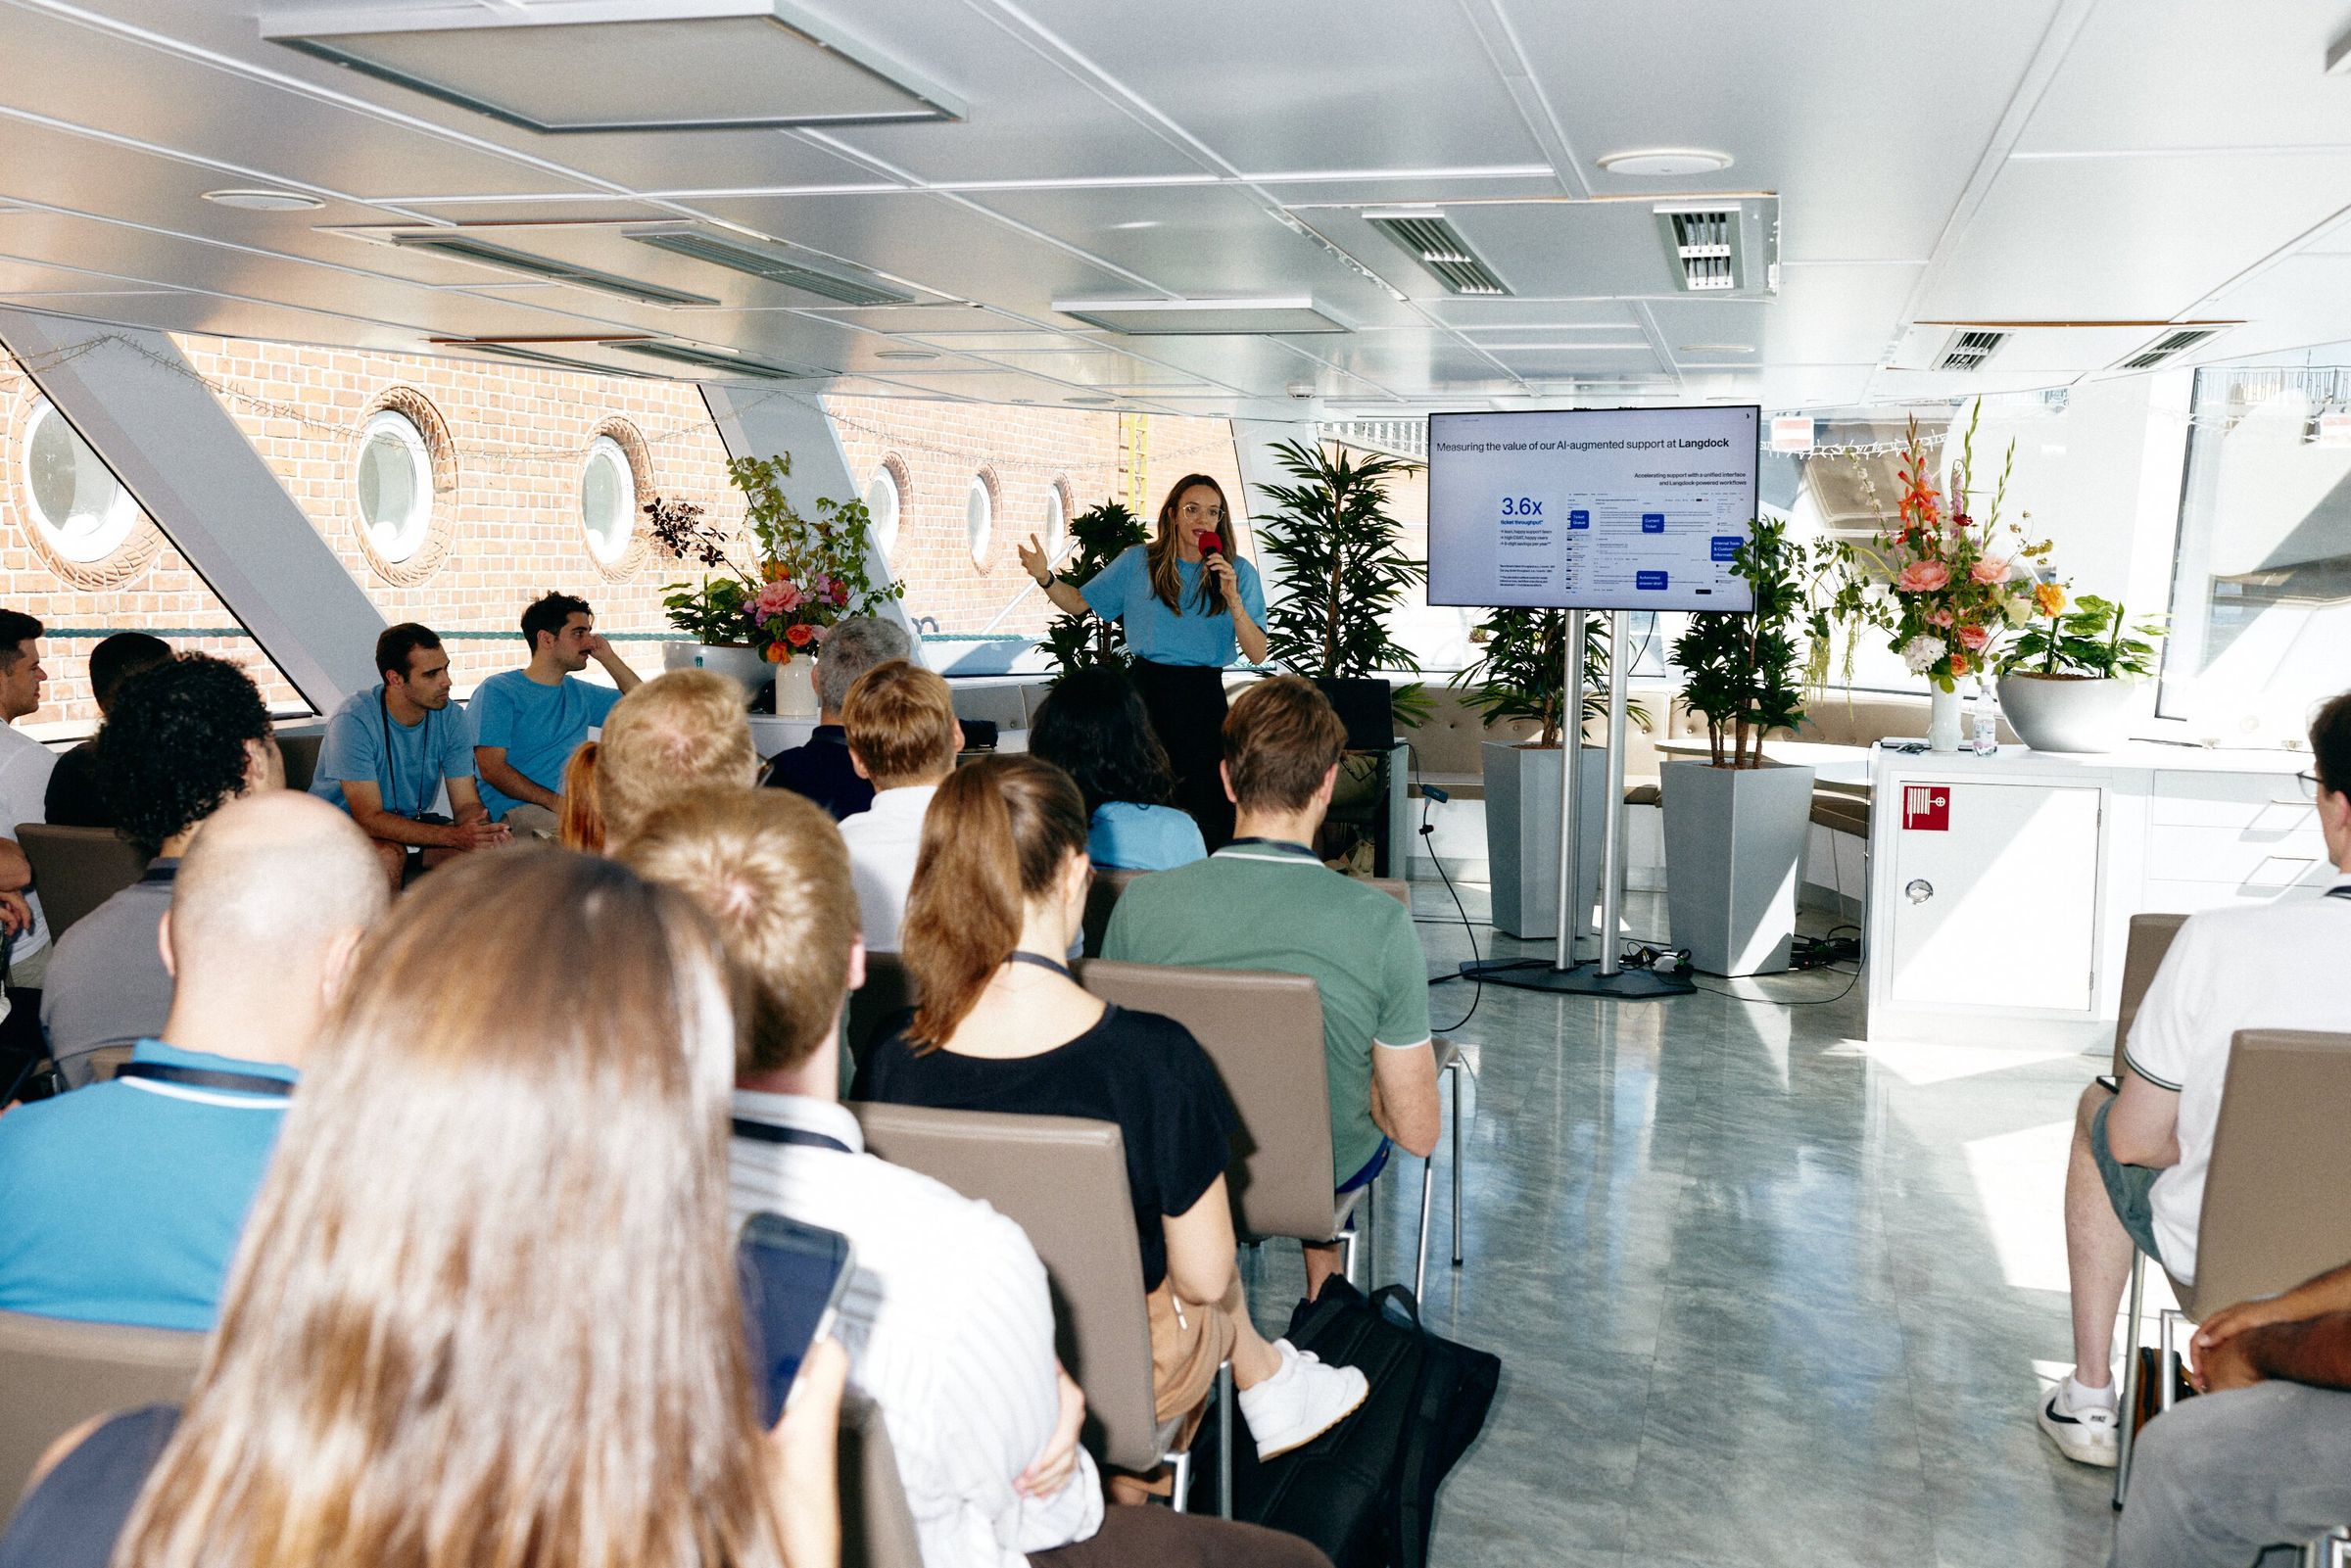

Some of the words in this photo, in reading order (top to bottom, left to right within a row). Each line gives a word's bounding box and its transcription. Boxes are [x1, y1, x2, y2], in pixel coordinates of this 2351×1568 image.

[1436, 442, 1484, 452] Measuring
[1486, 442, 1501, 451] the
[1502, 442, 1527, 451] value
[1528, 441, 1539, 451] of
[1557, 440, 1625, 451] AI-augmented
[1626, 440, 1664, 451] support
[1666, 440, 1677, 449] at
[1679, 438, 1730, 450] Langdock
[1502, 497, 1543, 515] 3.6x
